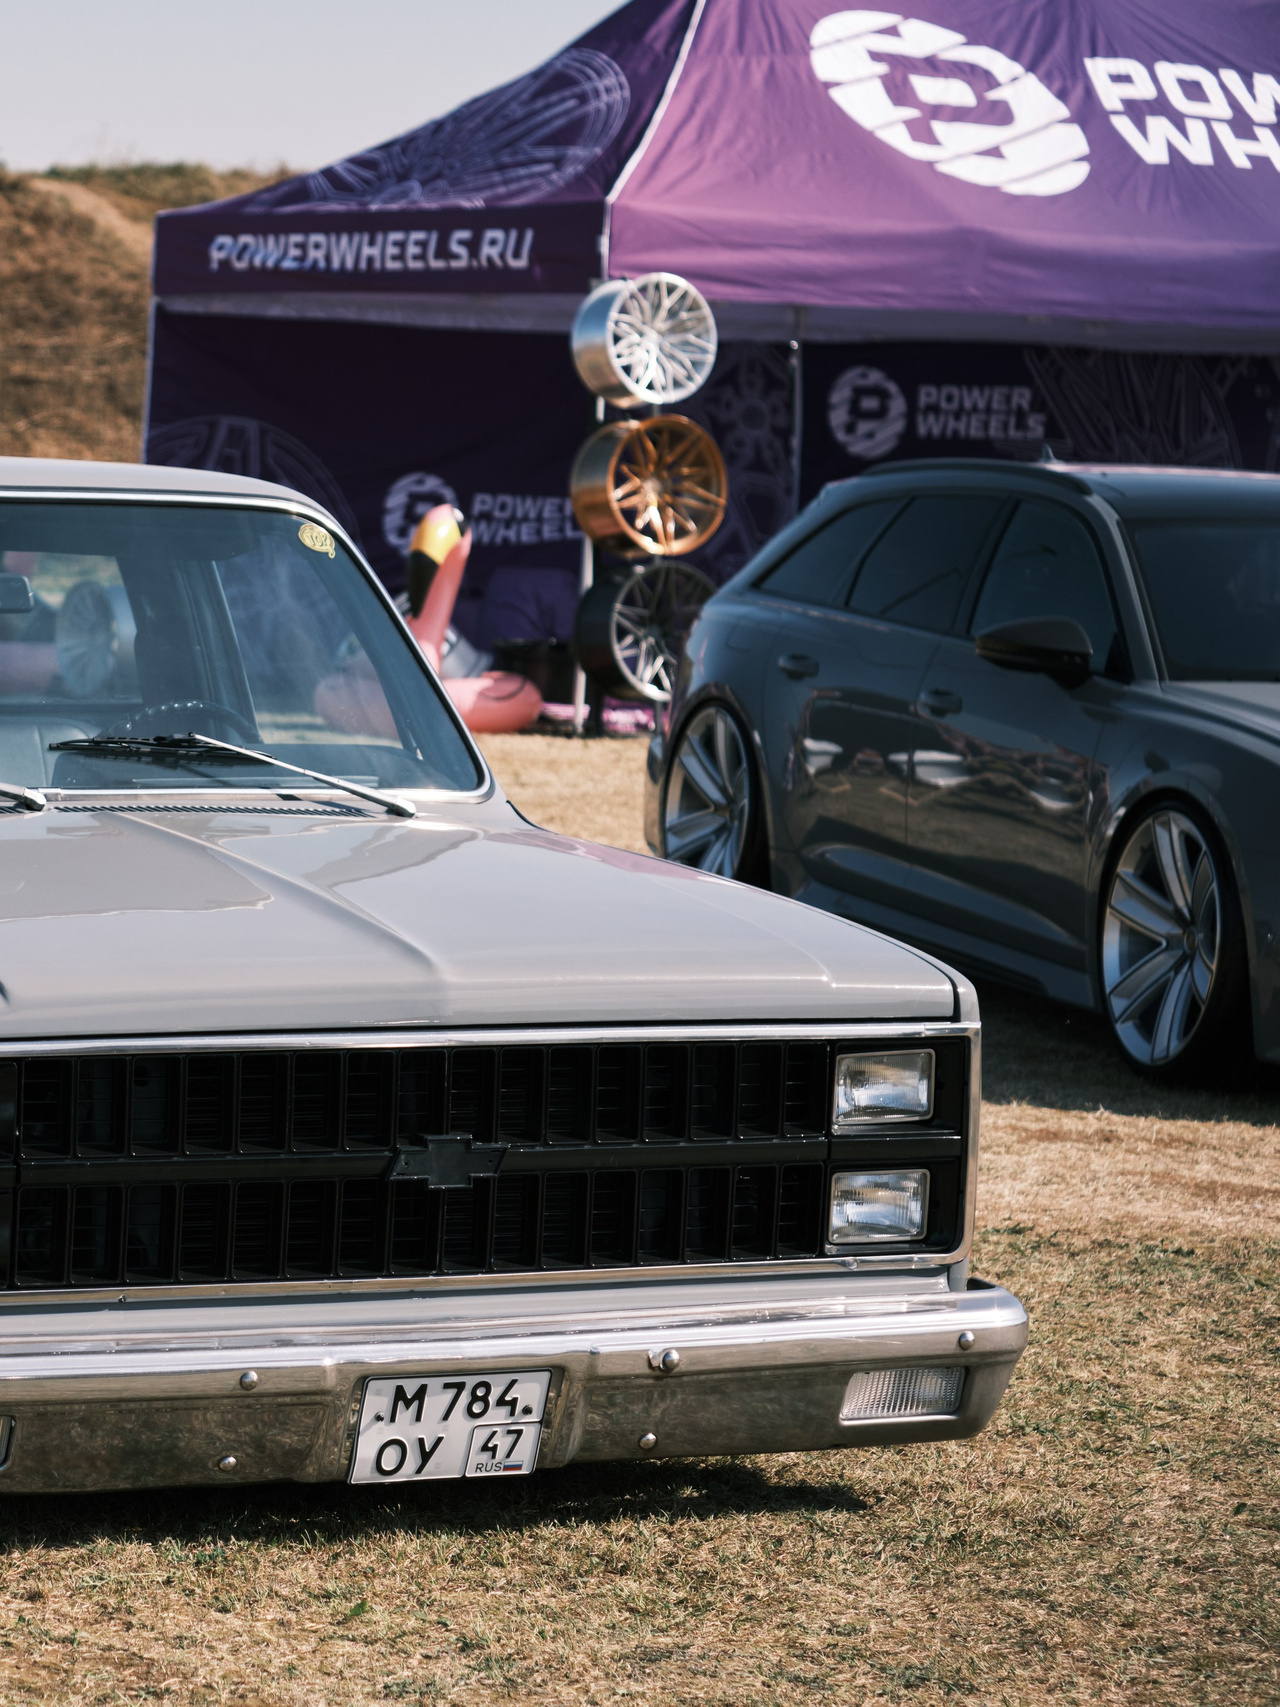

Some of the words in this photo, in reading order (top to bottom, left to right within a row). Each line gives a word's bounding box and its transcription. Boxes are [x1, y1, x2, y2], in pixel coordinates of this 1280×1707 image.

[1109, 114, 1280, 171] WH
[208, 228, 534, 272] POWERWHEELS.RU
[918, 384, 1033, 411] POWER
[916, 411, 1047, 440] WHEELS
[470, 520, 583, 546] WHEEL
[375, 1435, 445, 1476] OY
[480, 1429, 524, 1460] 47
[475, 1462, 502, 1473] RUS
